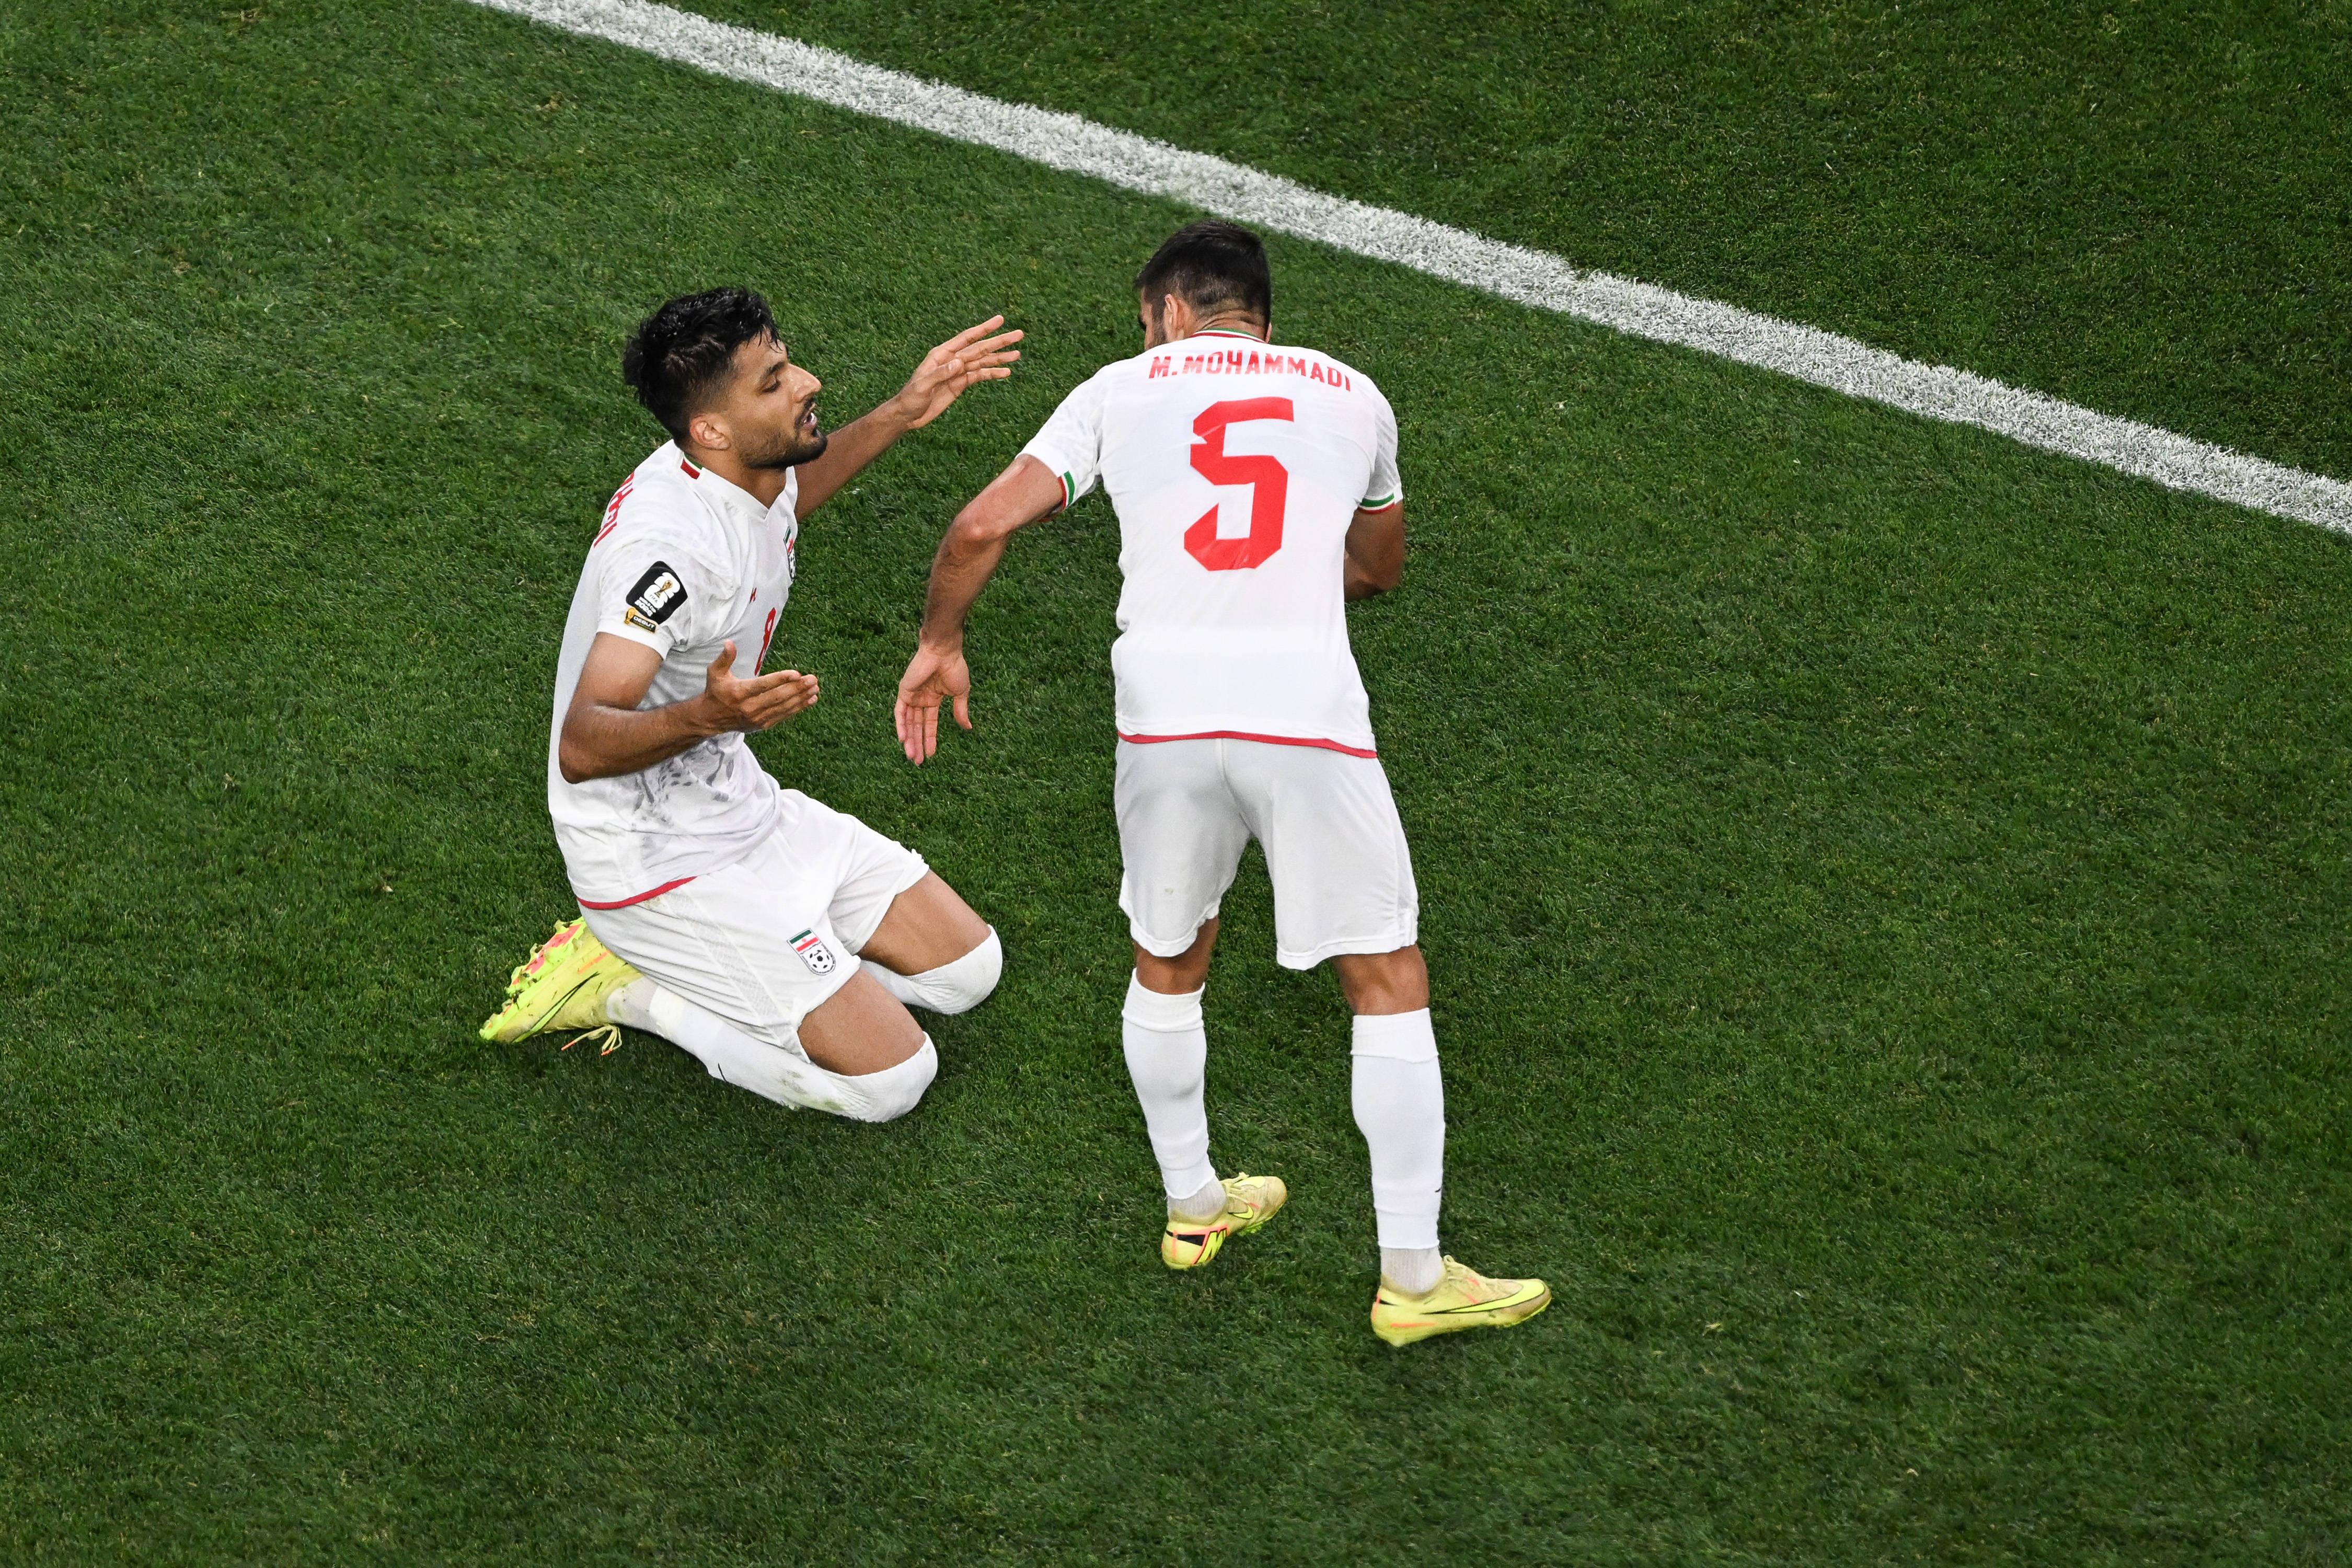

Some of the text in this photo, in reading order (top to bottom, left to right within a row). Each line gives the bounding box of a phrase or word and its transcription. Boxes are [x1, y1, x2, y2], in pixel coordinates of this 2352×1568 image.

[1149, 350, 1351, 391] M.MOHAMMADI
[1184, 397, 1294, 571] 5
[633, 616, 655, 628] DEBUT
[634, 599, 653, 617] 2026
